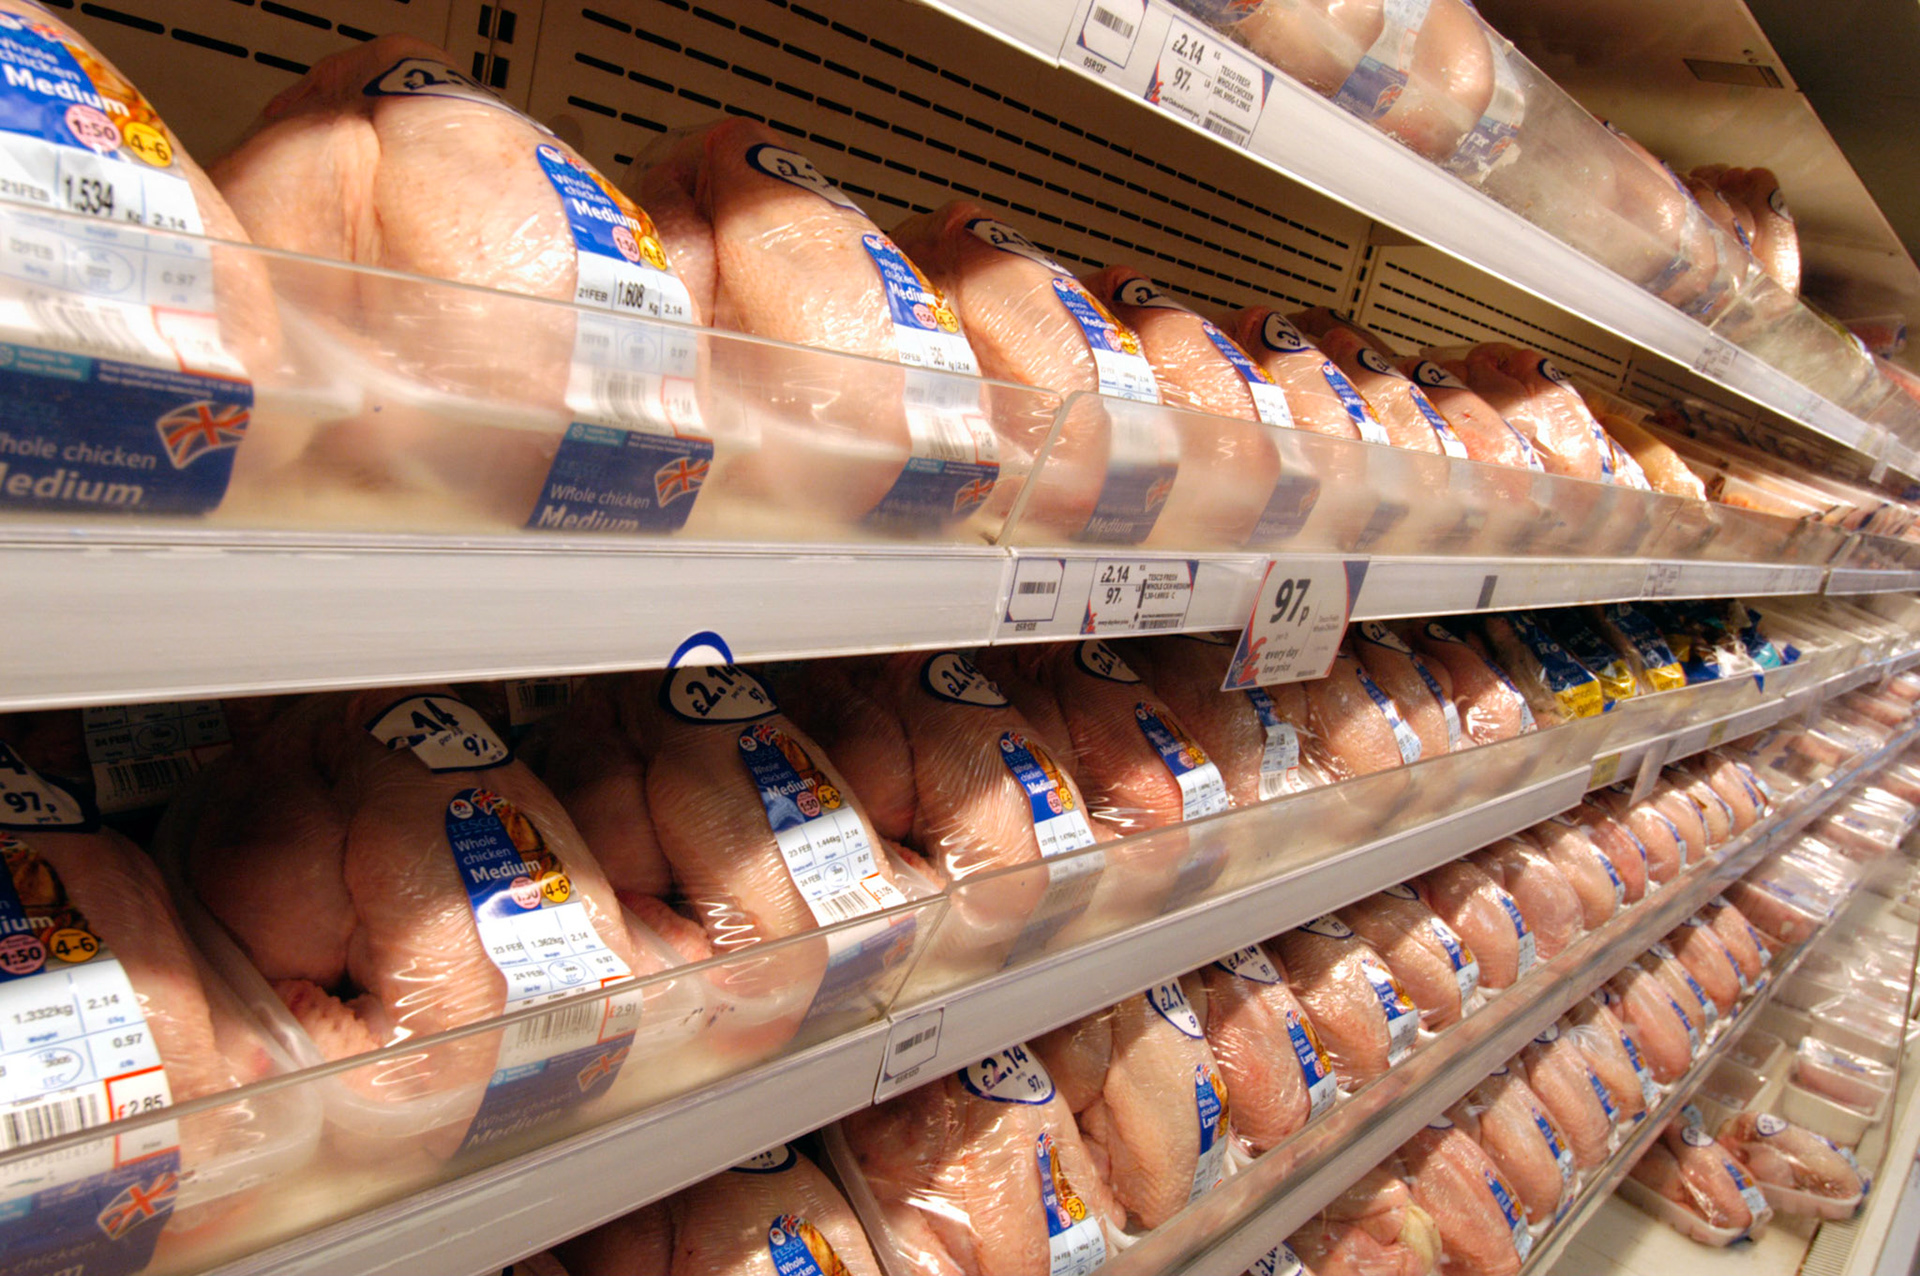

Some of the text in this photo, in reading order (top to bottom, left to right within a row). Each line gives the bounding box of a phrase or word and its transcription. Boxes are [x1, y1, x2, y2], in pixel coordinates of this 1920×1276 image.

[1172, 33, 1205, 65] £2.14
[1213, 51, 1221, 61] KG
[1221, 64, 1251, 88] TESCO FRESH
[2, 63, 131, 117] Medium
[1216, 75, 1254, 102] WHOLE CHICKEN
[72, 118, 118, 142] 1:50
[130, 134, 169, 161] 4-6
[551, 173, 596, 193] Whole
[64, 174, 114, 217] 1.534
[564, 186, 612, 207] chicken
[153, 212, 187, 230] 2.14
[571, 197, 642, 233] Medium
[578, 287, 608, 302] 21FEB
[618, 280, 660, 316] 1.608 Kg
[664, 303, 683, 317] 2.14
[62, 441, 157, 471] chicken
[550, 483, 650, 509] Whole chicken
[537, 504, 639, 531] Medium
[1088, 516, 1134, 534] Medium
[1100, 564, 1130, 584] £2.14
[1148, 573, 1178, 581] TESCO FRESH
[1269, 578, 1311, 627] 97p
[1265, 649, 1285, 661] every
[1285, 646, 1300, 660] day
[1262, 662, 1291, 674] low price
[761, 770, 793, 784] chicken
[1021, 770, 1043, 782] chicken
[766, 777, 816, 800] Medium
[821, 790, 839, 805] 4-6
[800, 799, 818, 812] 1:50
[450, 816, 498, 833] TESCO
[454, 835, 498, 852] Whole
[845, 829, 859, 840] 2.14
[463, 847, 512, 866] chicken
[798, 843, 813, 854] FEB
[470, 860, 541, 884] Medium
[808, 873, 821, 884] FEB
[545, 879, 568, 897] 4-6
[570, 931, 589, 942] 2.14
[56, 936, 95, 956] 4-6
[505, 942, 525, 953] FEB
[527, 969, 545, 978] FEB
[87, 993, 120, 1010] 2.14
[1161, 982, 1187, 1011] £2.1
[13, 1004, 74, 1024] 1.332kg
[608, 1003, 637, 1019] £2.91
[112, 1032, 143, 1049] 0.97
[981, 1044, 1029, 1091] £2.14
[773, 1238, 803, 1258] TESCO
[1061, 1250, 1071, 1260] FEB
[779, 1256, 806, 1275] Whole
